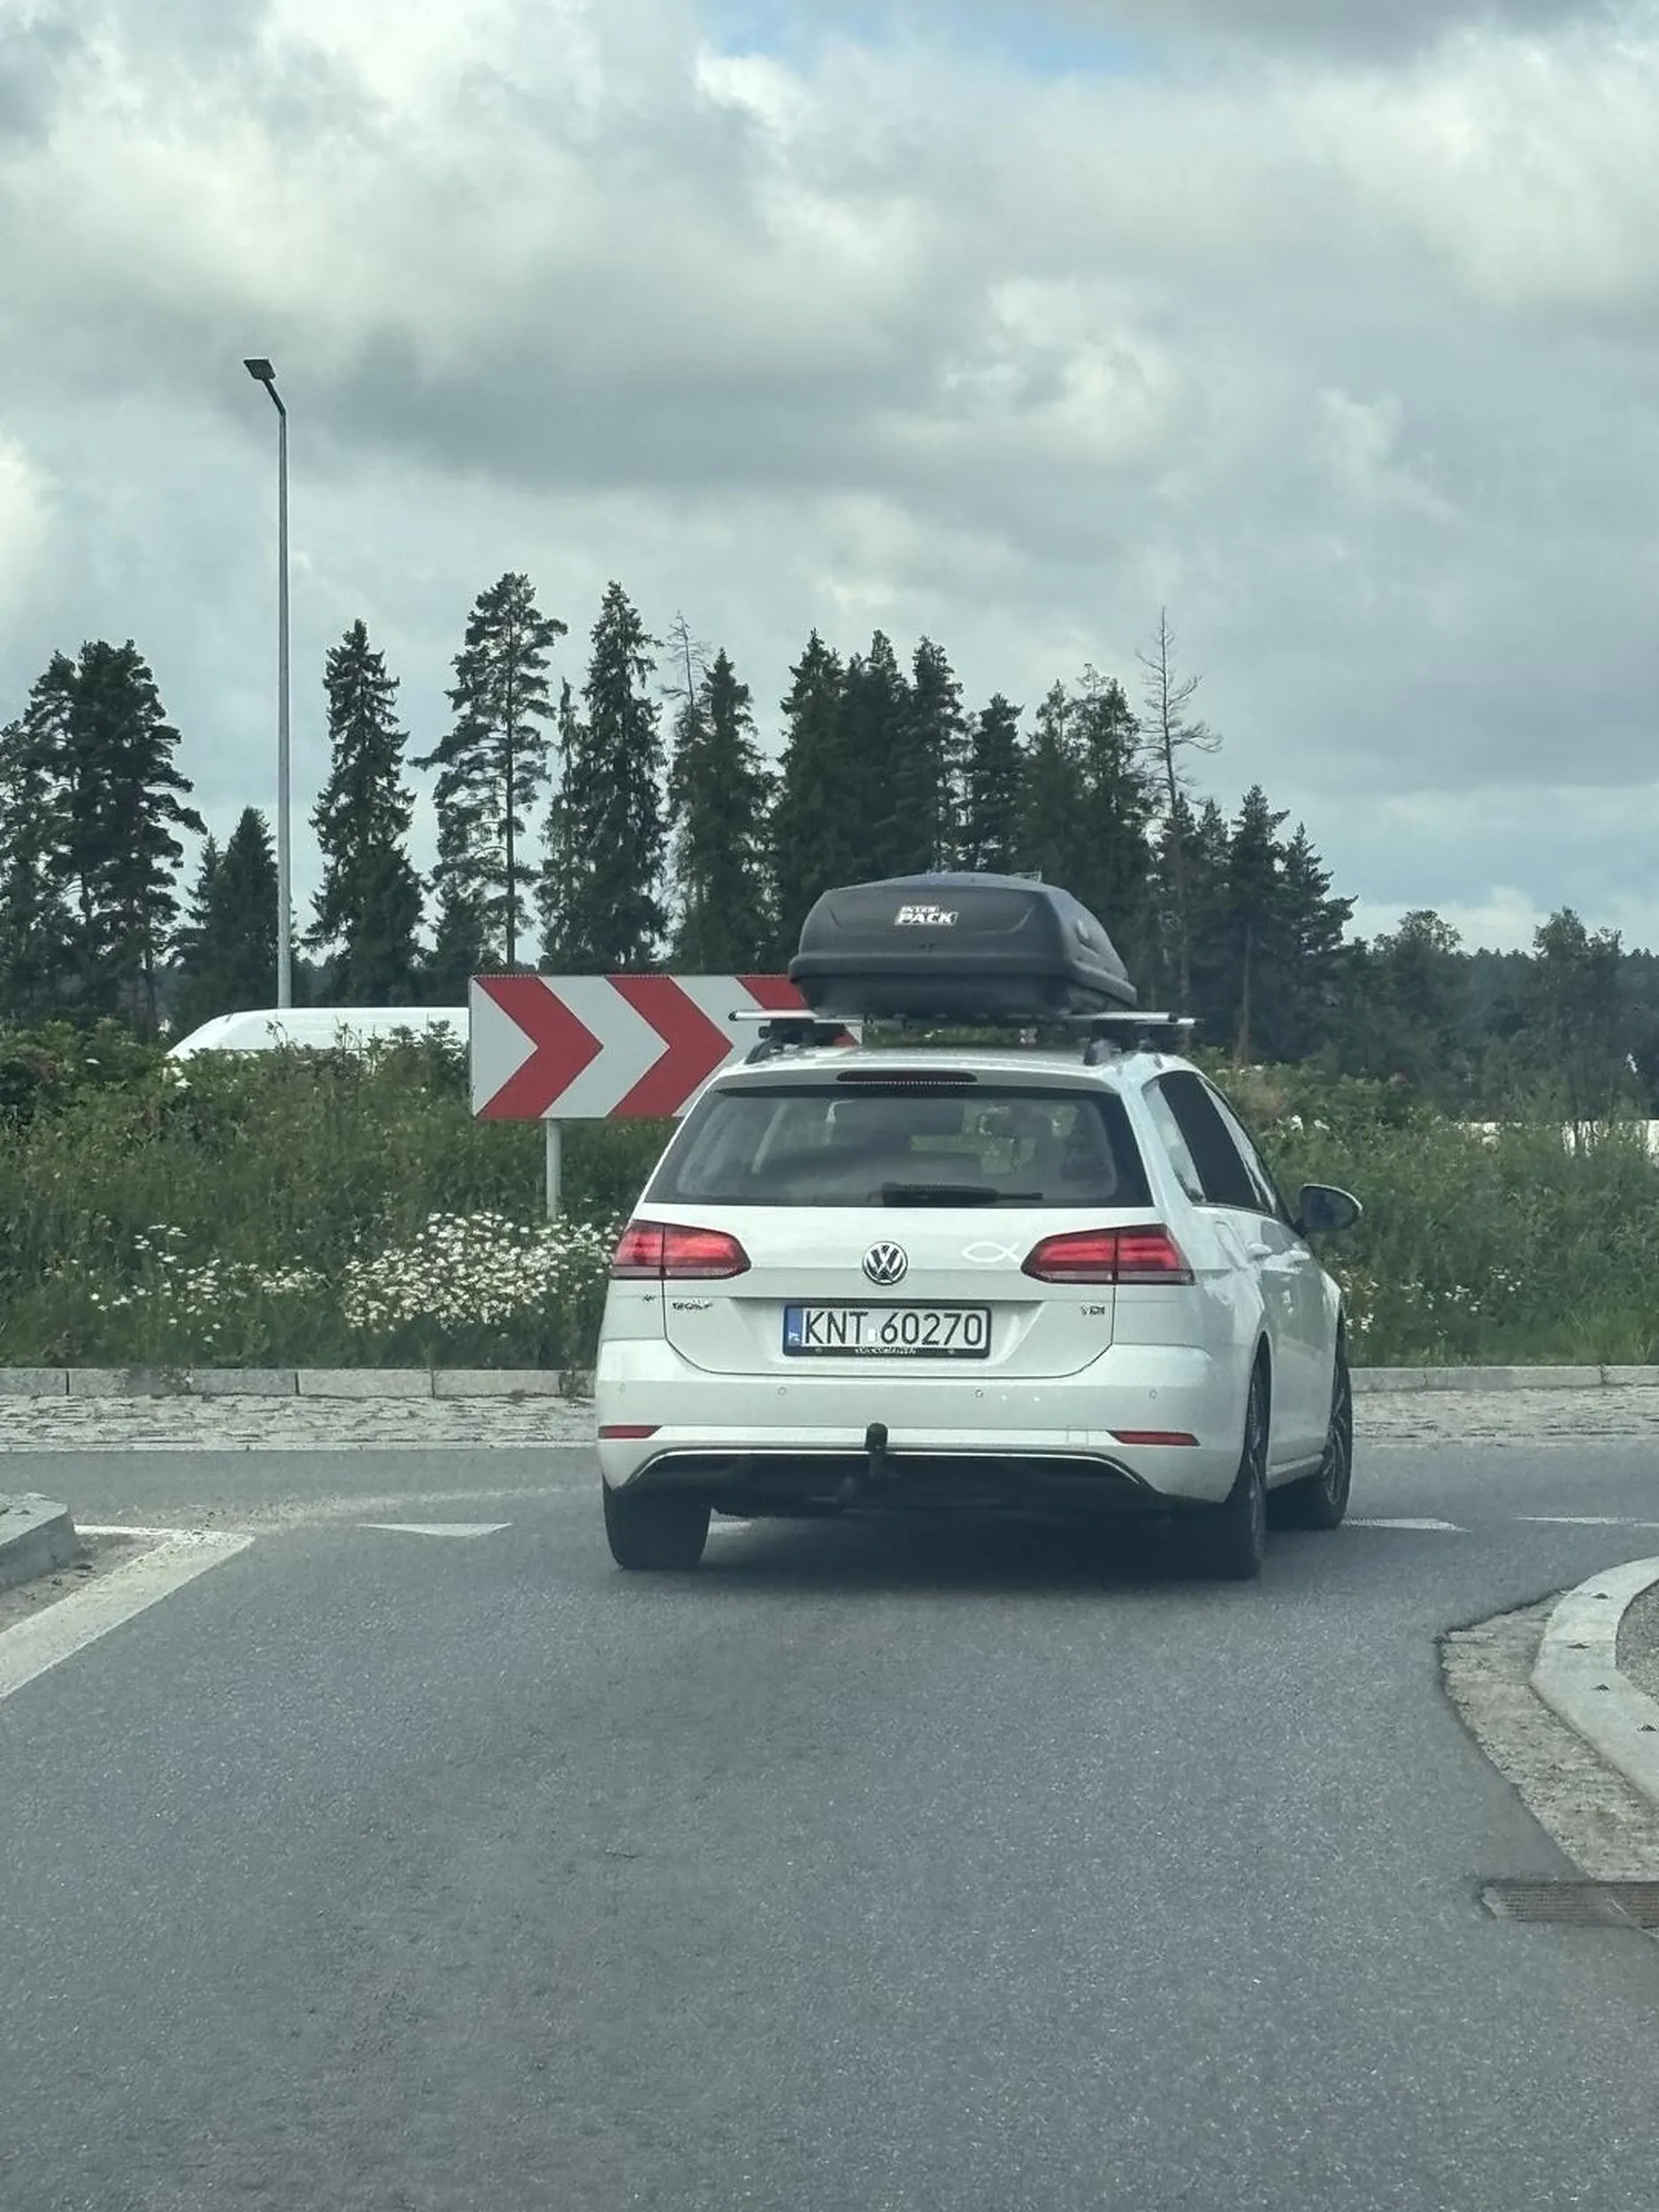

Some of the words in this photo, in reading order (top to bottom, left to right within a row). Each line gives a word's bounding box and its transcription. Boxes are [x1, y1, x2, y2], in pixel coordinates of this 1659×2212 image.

[897, 912, 957, 925] PACK
[804, 1310, 869, 1345] KNT
[880, 1312, 983, 1347] 60270
